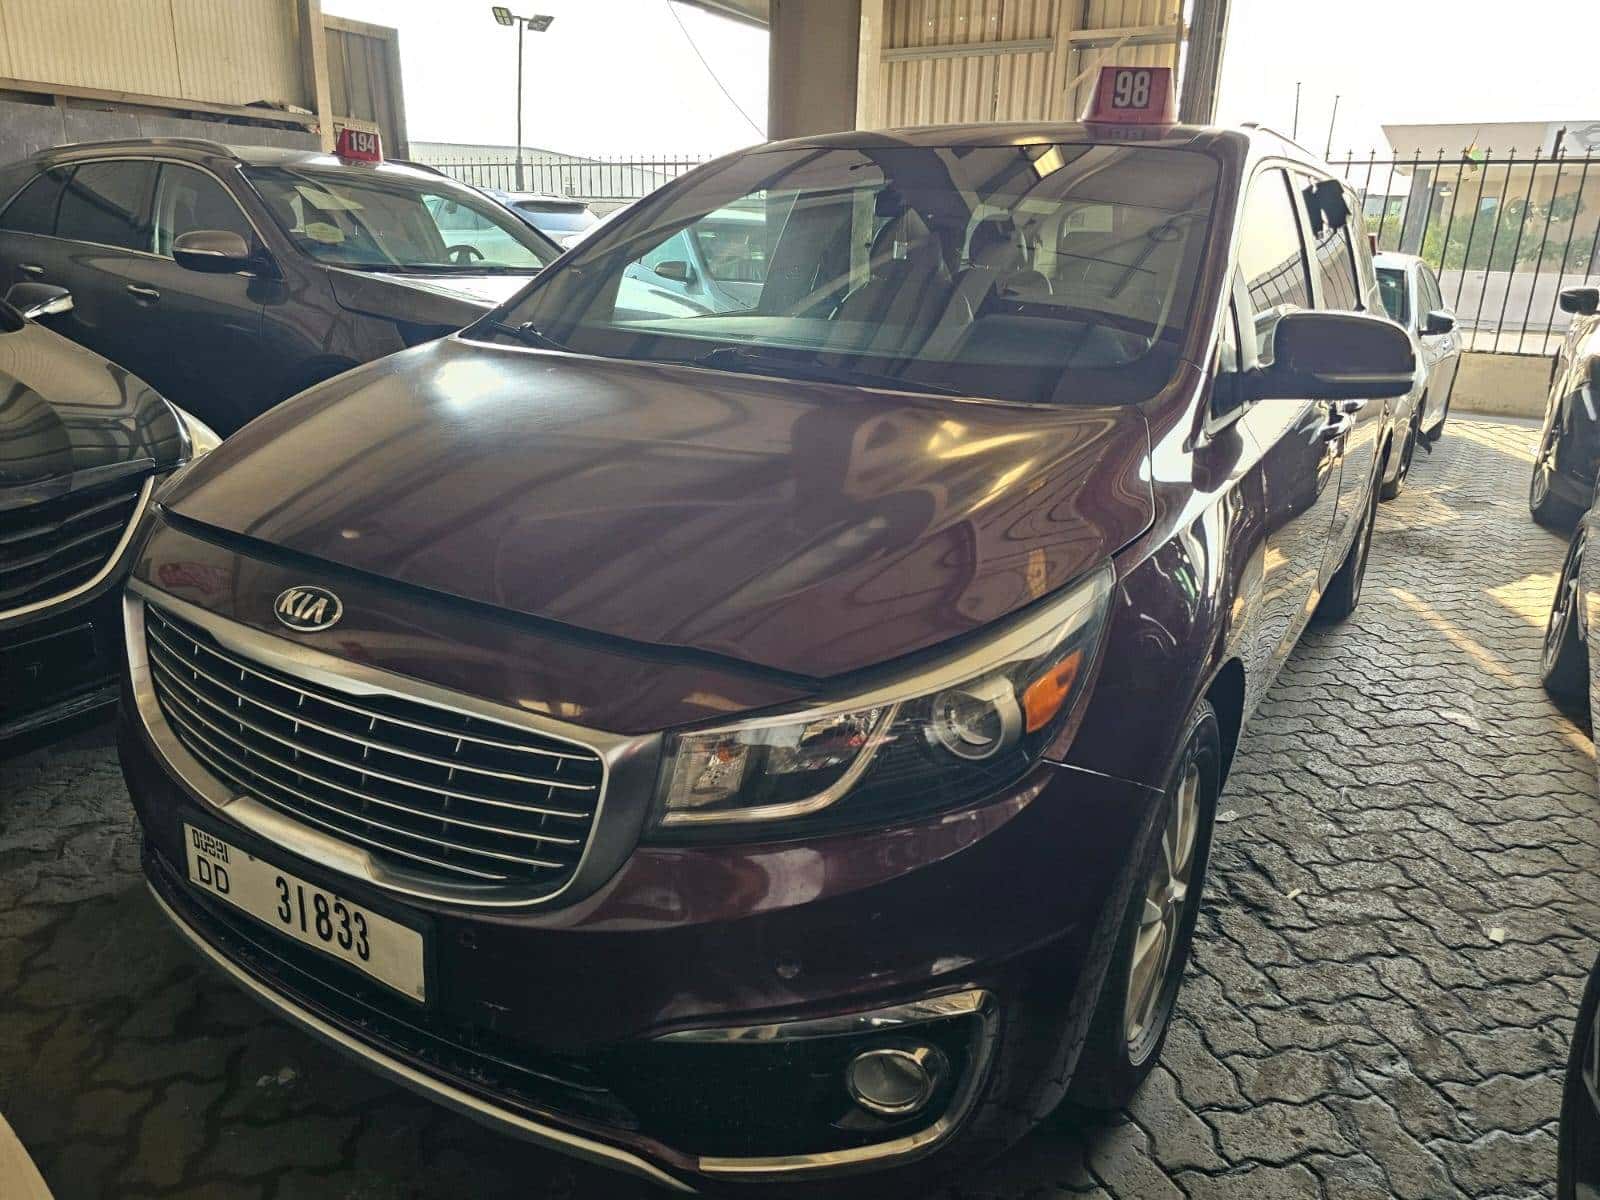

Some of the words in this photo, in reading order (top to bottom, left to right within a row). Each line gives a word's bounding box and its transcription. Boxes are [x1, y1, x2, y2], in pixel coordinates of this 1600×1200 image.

[1114, 71, 1150, 108] 98
[351, 132, 376, 155] 194
[279, 590, 328, 624] KIA
[197, 854, 230, 894] DD
[276, 876, 370, 962] 31833
